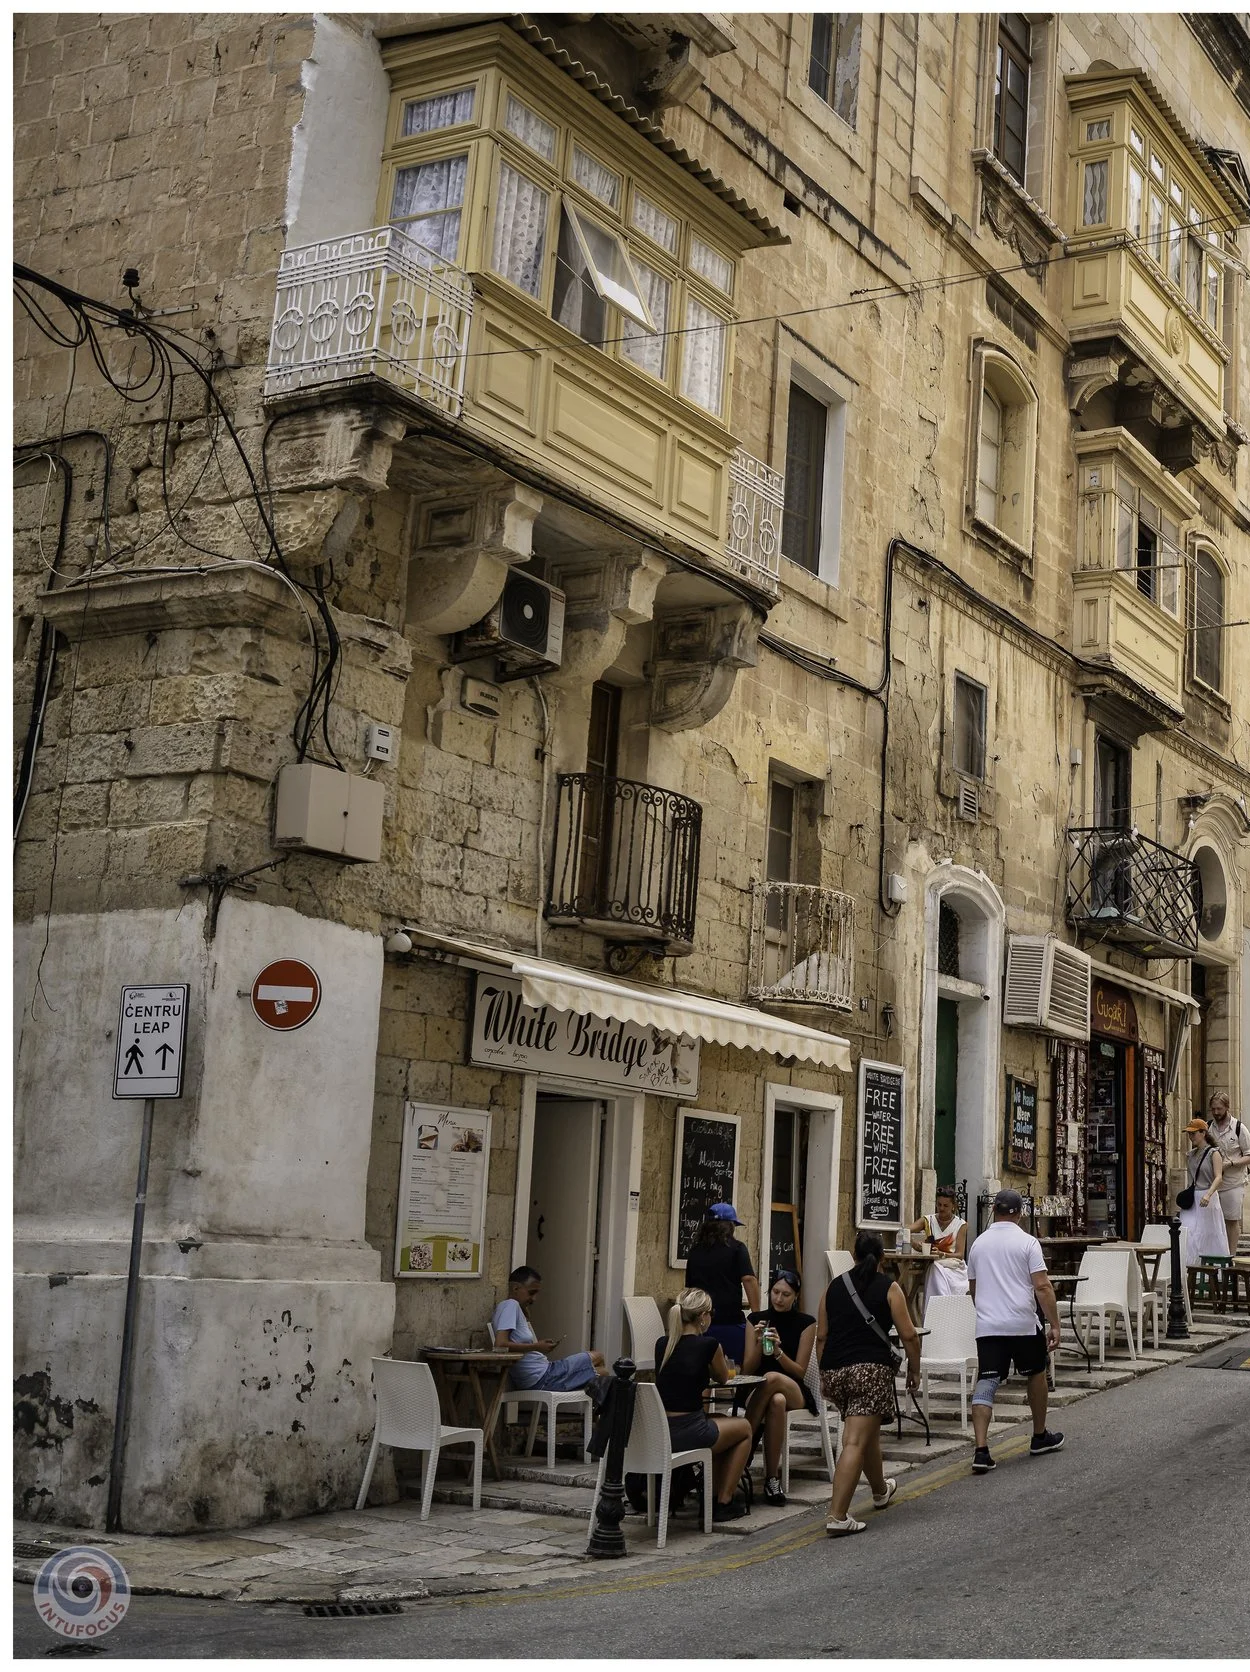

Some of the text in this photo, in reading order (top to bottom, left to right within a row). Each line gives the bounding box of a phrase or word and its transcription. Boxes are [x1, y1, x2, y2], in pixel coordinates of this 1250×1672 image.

[124, 1003, 181, 1018] ĊENTRU
[133, 1021, 170, 1034] LEAP
[480, 986, 649, 1078] White Bridge
[865, 1088, 897, 1110] FREE
[872, 1110, 892, 1122] WATER
[864, 1120, 895, 1145] FREE
[873, 1143, 889, 1156] WIFI
[864, 1156, 897, 1178] FREE
[871, 1178, 894, 1195] HUGS
